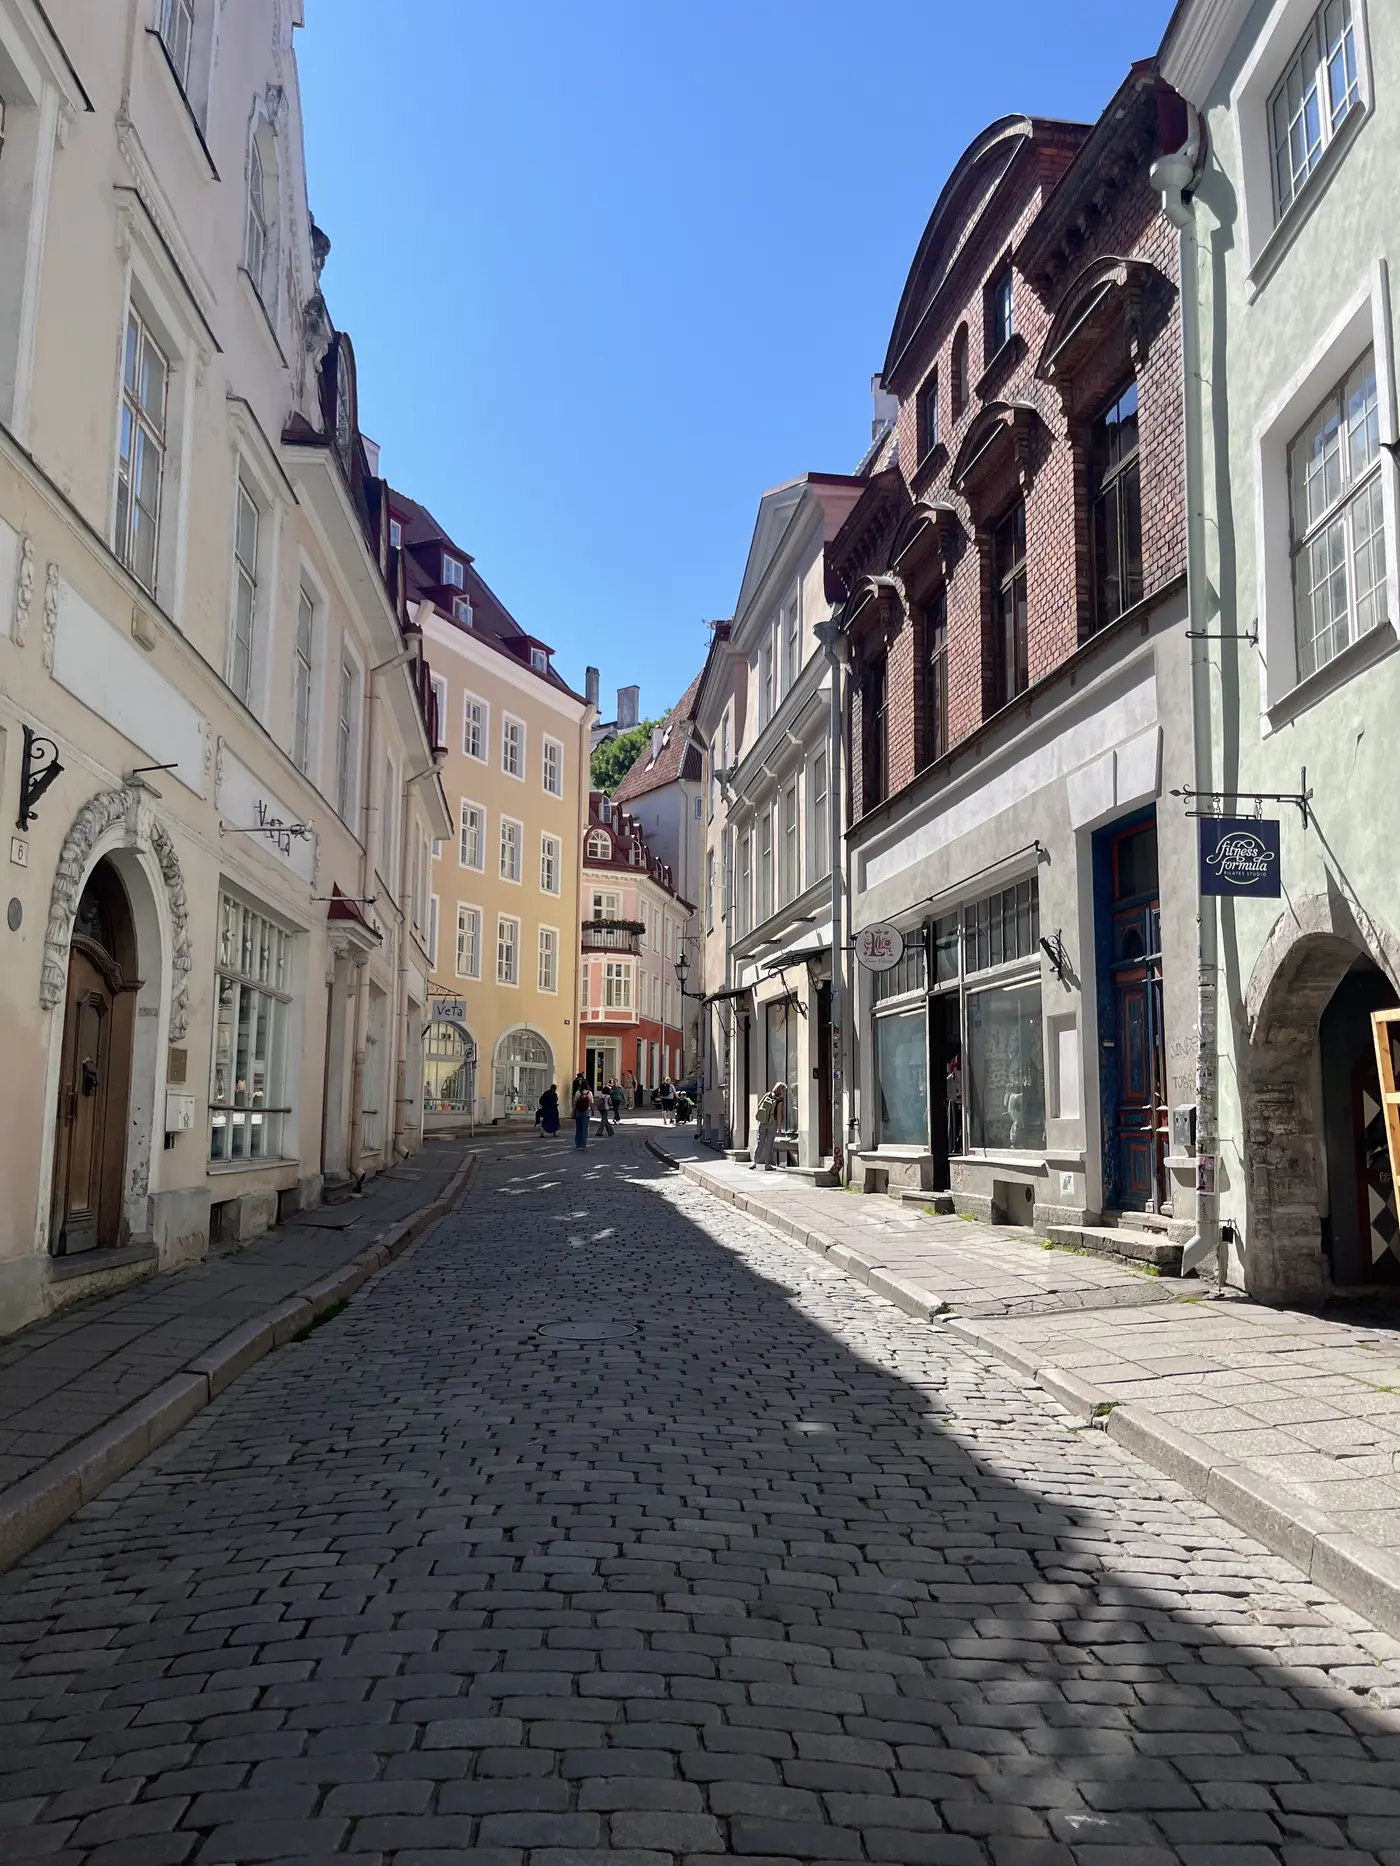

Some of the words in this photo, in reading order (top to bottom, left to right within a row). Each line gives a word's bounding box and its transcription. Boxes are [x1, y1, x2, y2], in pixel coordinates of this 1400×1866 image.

[17, 844, 24, 861] 6
[1206, 839, 1259, 865] fitness
[1215, 852, 1275, 876] formula
[437, 1005, 464, 1018] VeTa
